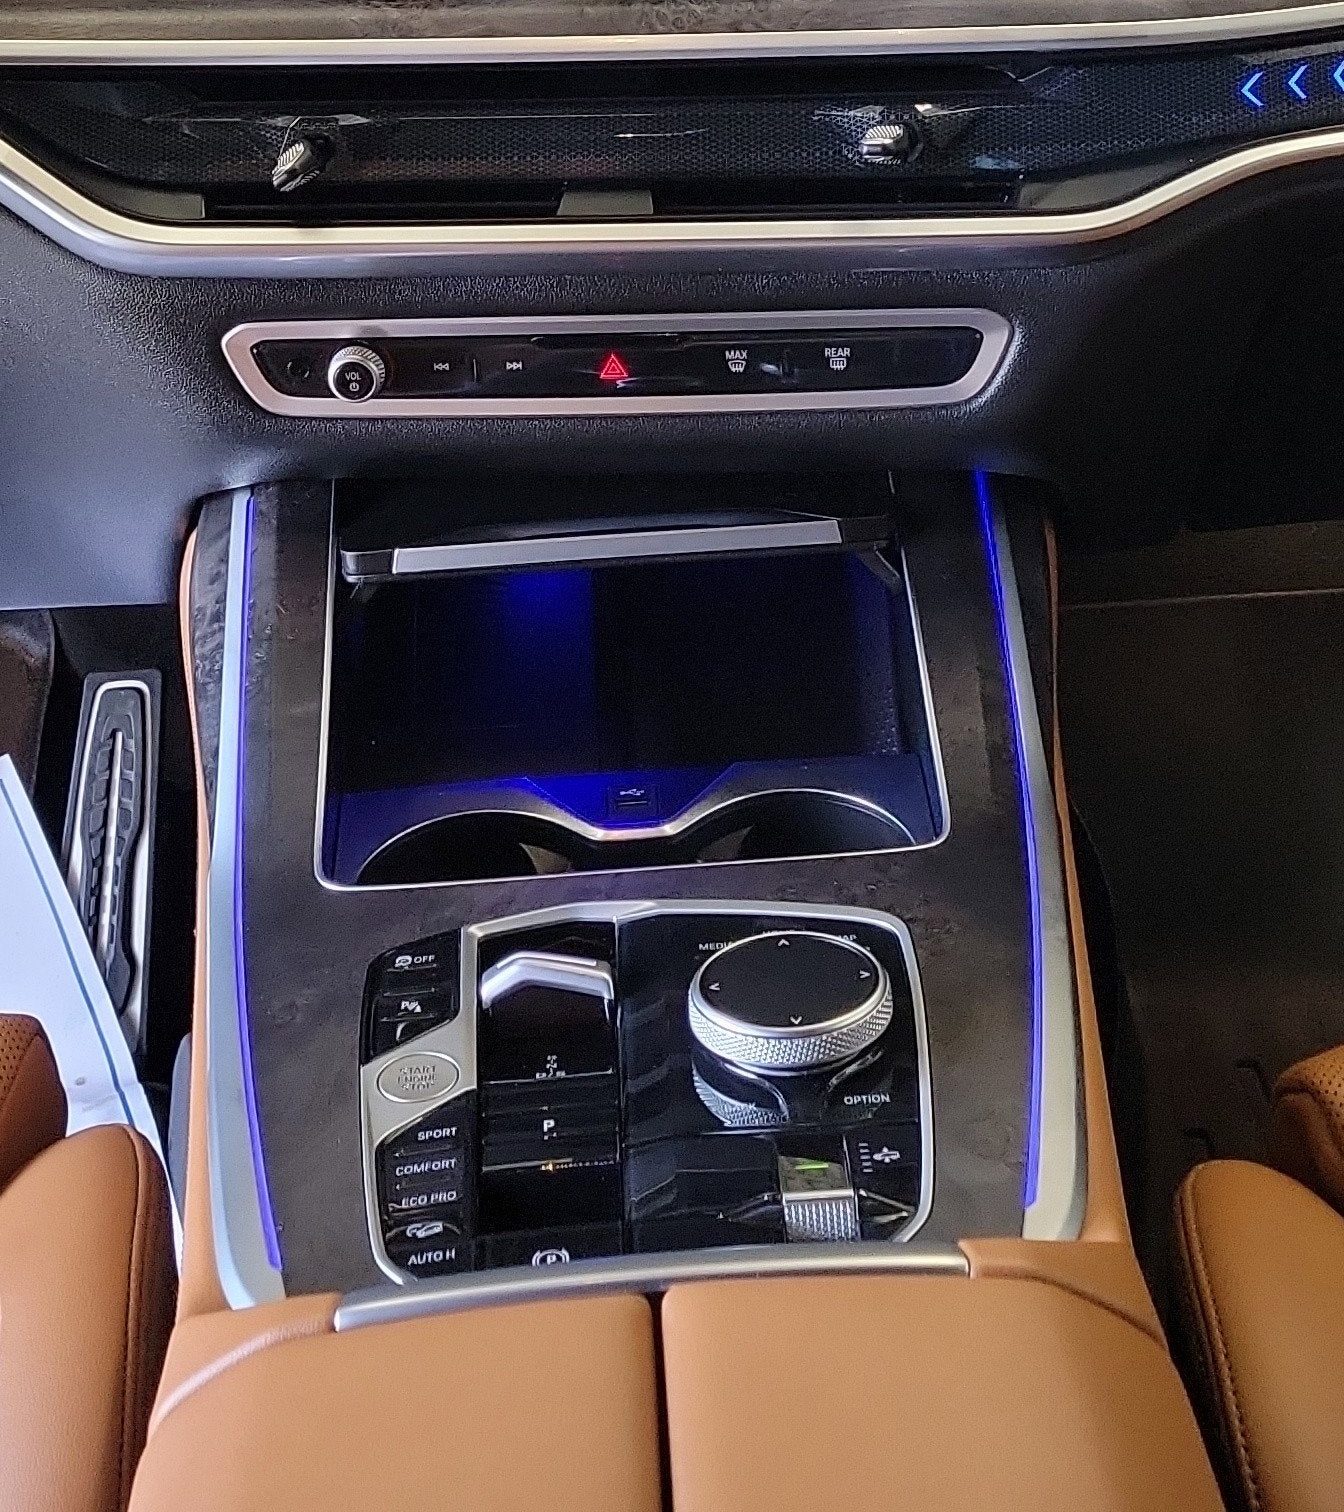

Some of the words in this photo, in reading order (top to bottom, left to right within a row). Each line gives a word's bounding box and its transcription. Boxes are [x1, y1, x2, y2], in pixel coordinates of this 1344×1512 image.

[725, 349, 748, 360] MAX
[824, 347, 851, 358] REAR
[344, 372, 362, 381] VOL
[413, 955, 435, 964] OFF
[399, 1065, 436, 1075] START
[400, 1082, 435, 1091] STOP
[843, 1093, 891, 1105] OPTION
[543, 1118, 556, 1133] P
[417, 1127, 458, 1141] SPORT
[395, 1157, 457, 1177] COMFORT
[407, 1250, 444, 1266] AUTO
[445, 1248, 456, 1260] H
